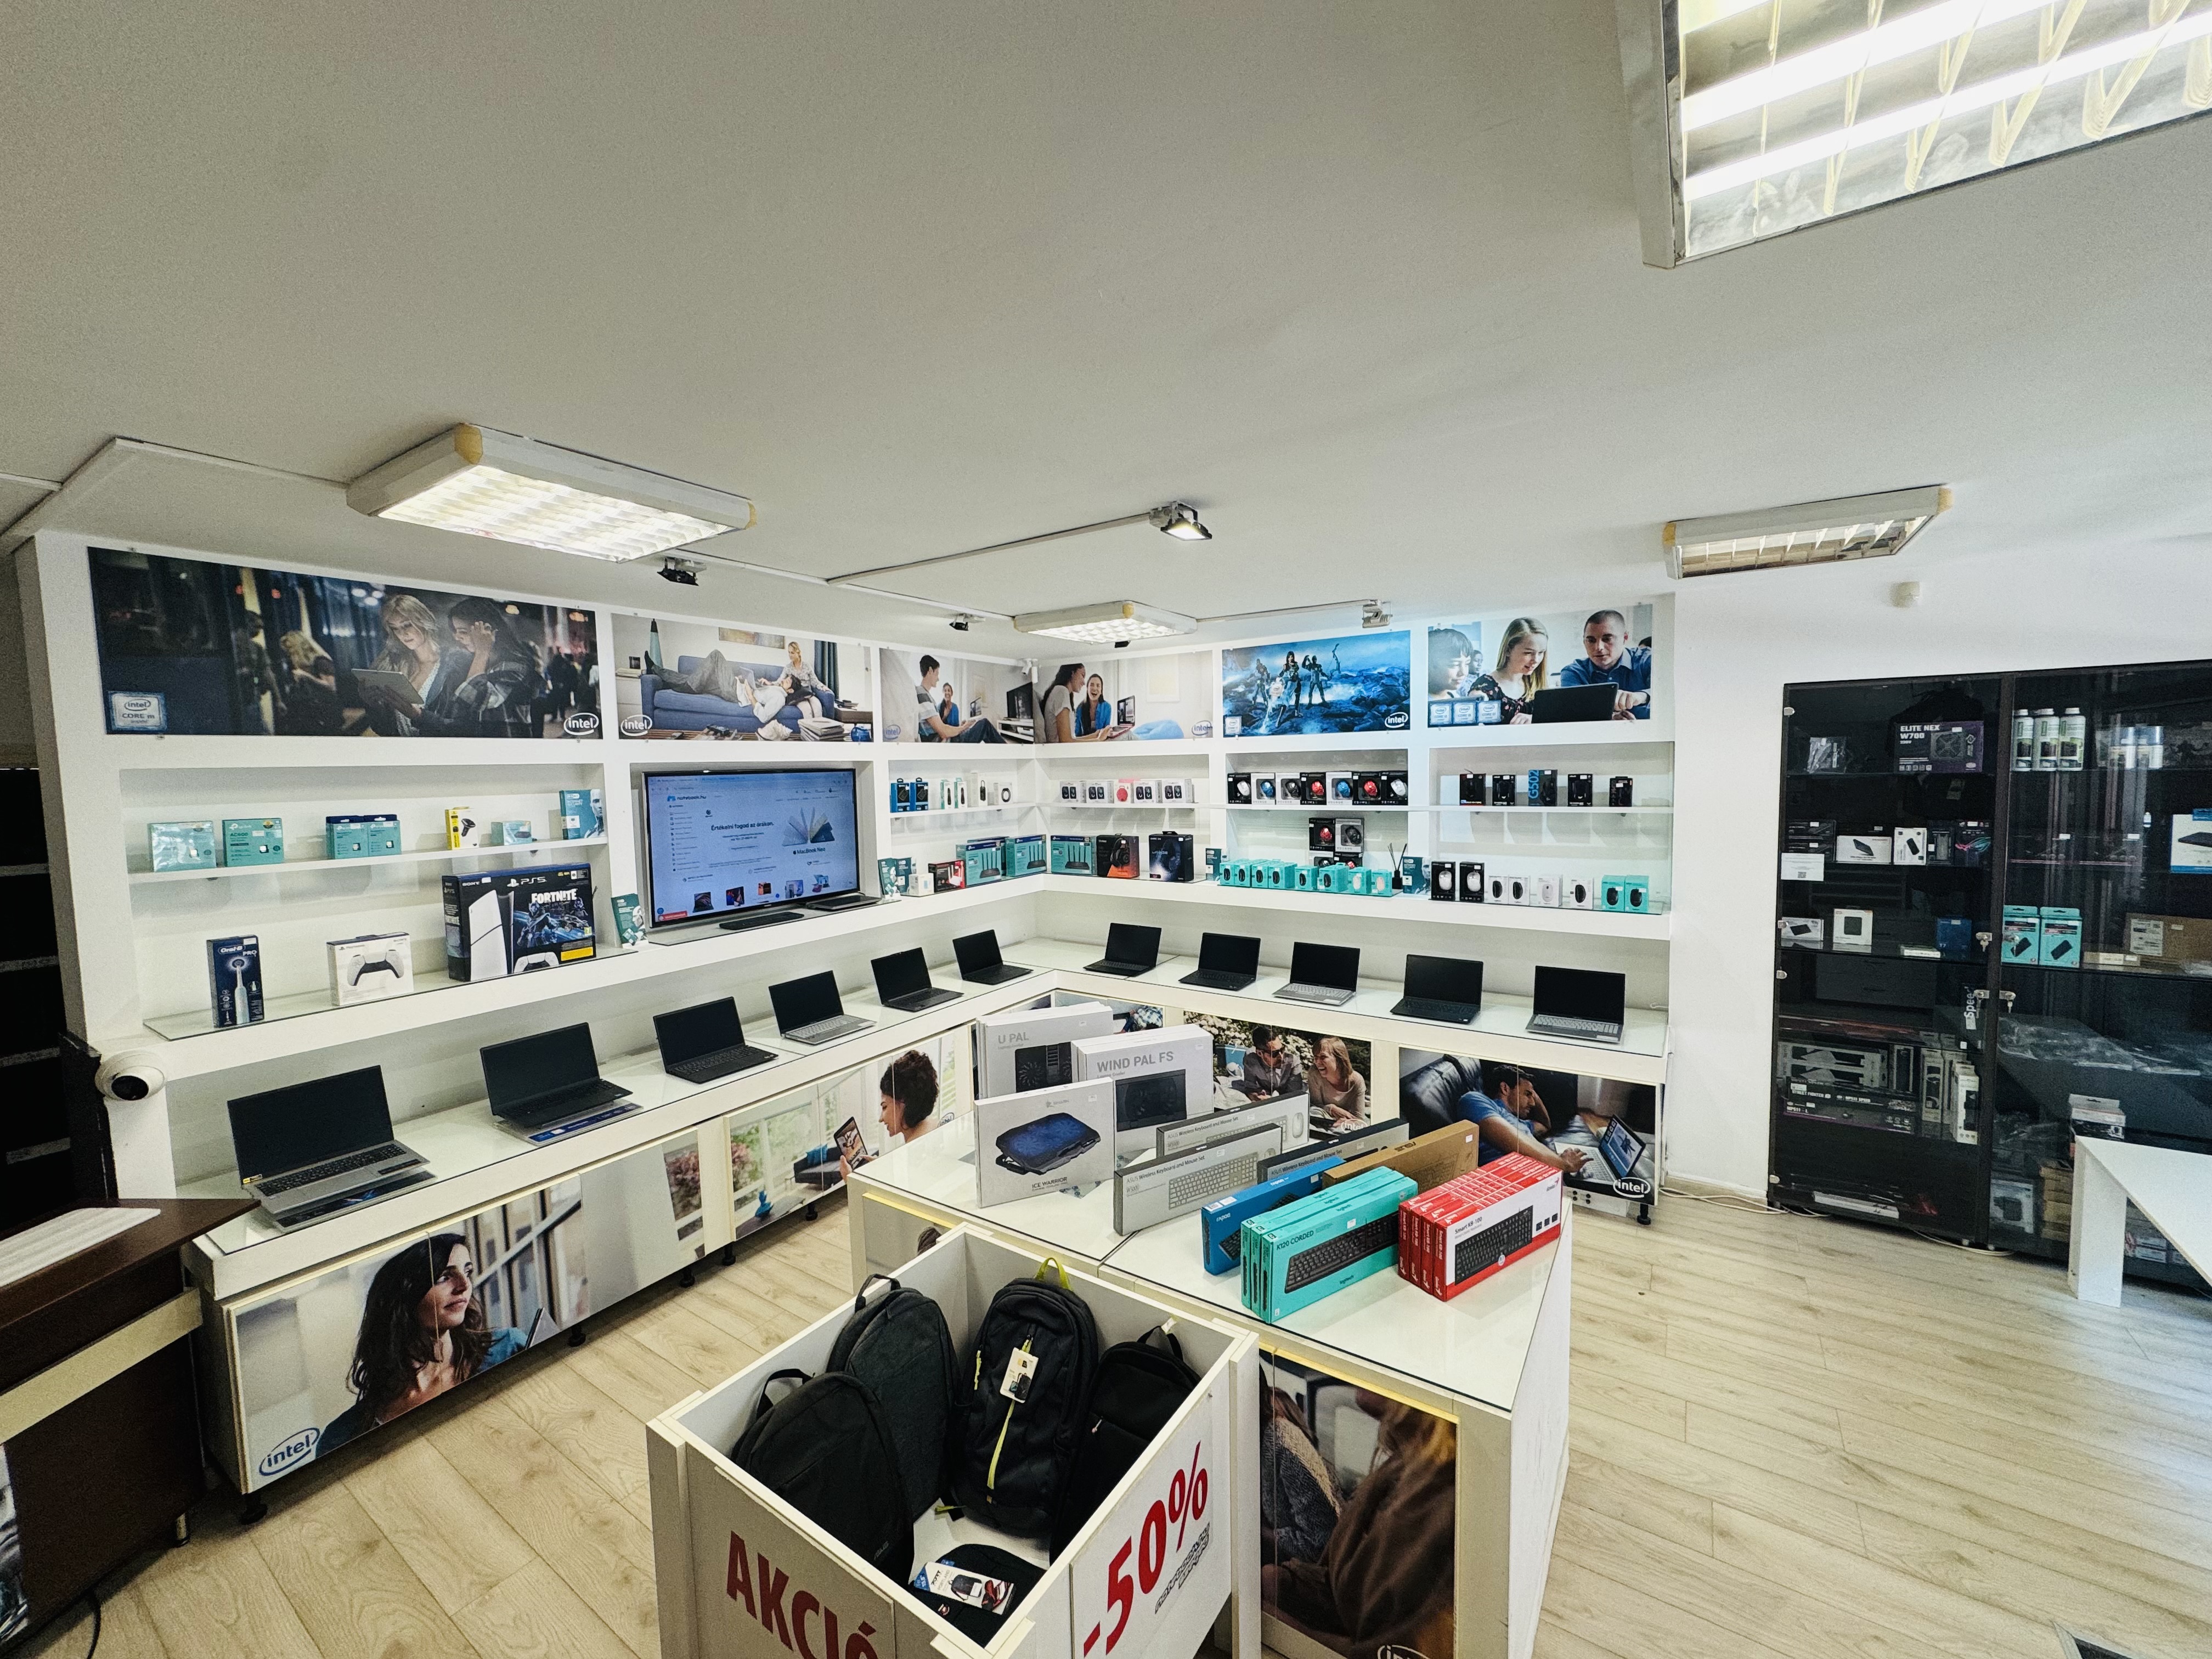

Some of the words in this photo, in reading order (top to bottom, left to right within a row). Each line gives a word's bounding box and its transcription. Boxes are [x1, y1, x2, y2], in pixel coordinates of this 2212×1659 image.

[1528, 770, 1539, 799] G502
[531, 889, 577, 904] FORTNITE
[1963, 986, 1977, 1017] Spee
[998, 1035, 1006, 1043] U
[1009, 1032, 1029, 1042] PAL
[1097, 1058, 1130, 1072] WIND
[1133, 1054, 1156, 1067] PAL
[1159, 1051, 1175, 1063] FS
[1179, 1128, 1194, 1136] Wireless
[1194, 1122, 1212, 1132] Keyboard
[1138, 1170, 1156, 1180] Wireless
[1156, 1164, 1176, 1175] Keyboard
[1282, 1163, 1299, 1172] Wireless
[1298, 1158, 1316, 1167] Keyboard
[1042, 1177, 1068, 1186] WARRIOR
[1618, 1178, 1645, 1193] intel
[1313, 1191, 1330, 1199] logitech
[1324, 1196, 1340, 1204] logitech
[1335, 1203, 1353, 1212] logitech
[1454, 1224, 1468, 1234] Smart
[1468, 1216, 1483, 1227] KB-100
[1290, 1231, 1314, 1245] CORDED
[1339, 1274, 1355, 1285] logitech
[267, 1434, 310, 1468] intel
[1084, 1440, 1208, 1658] -50%
